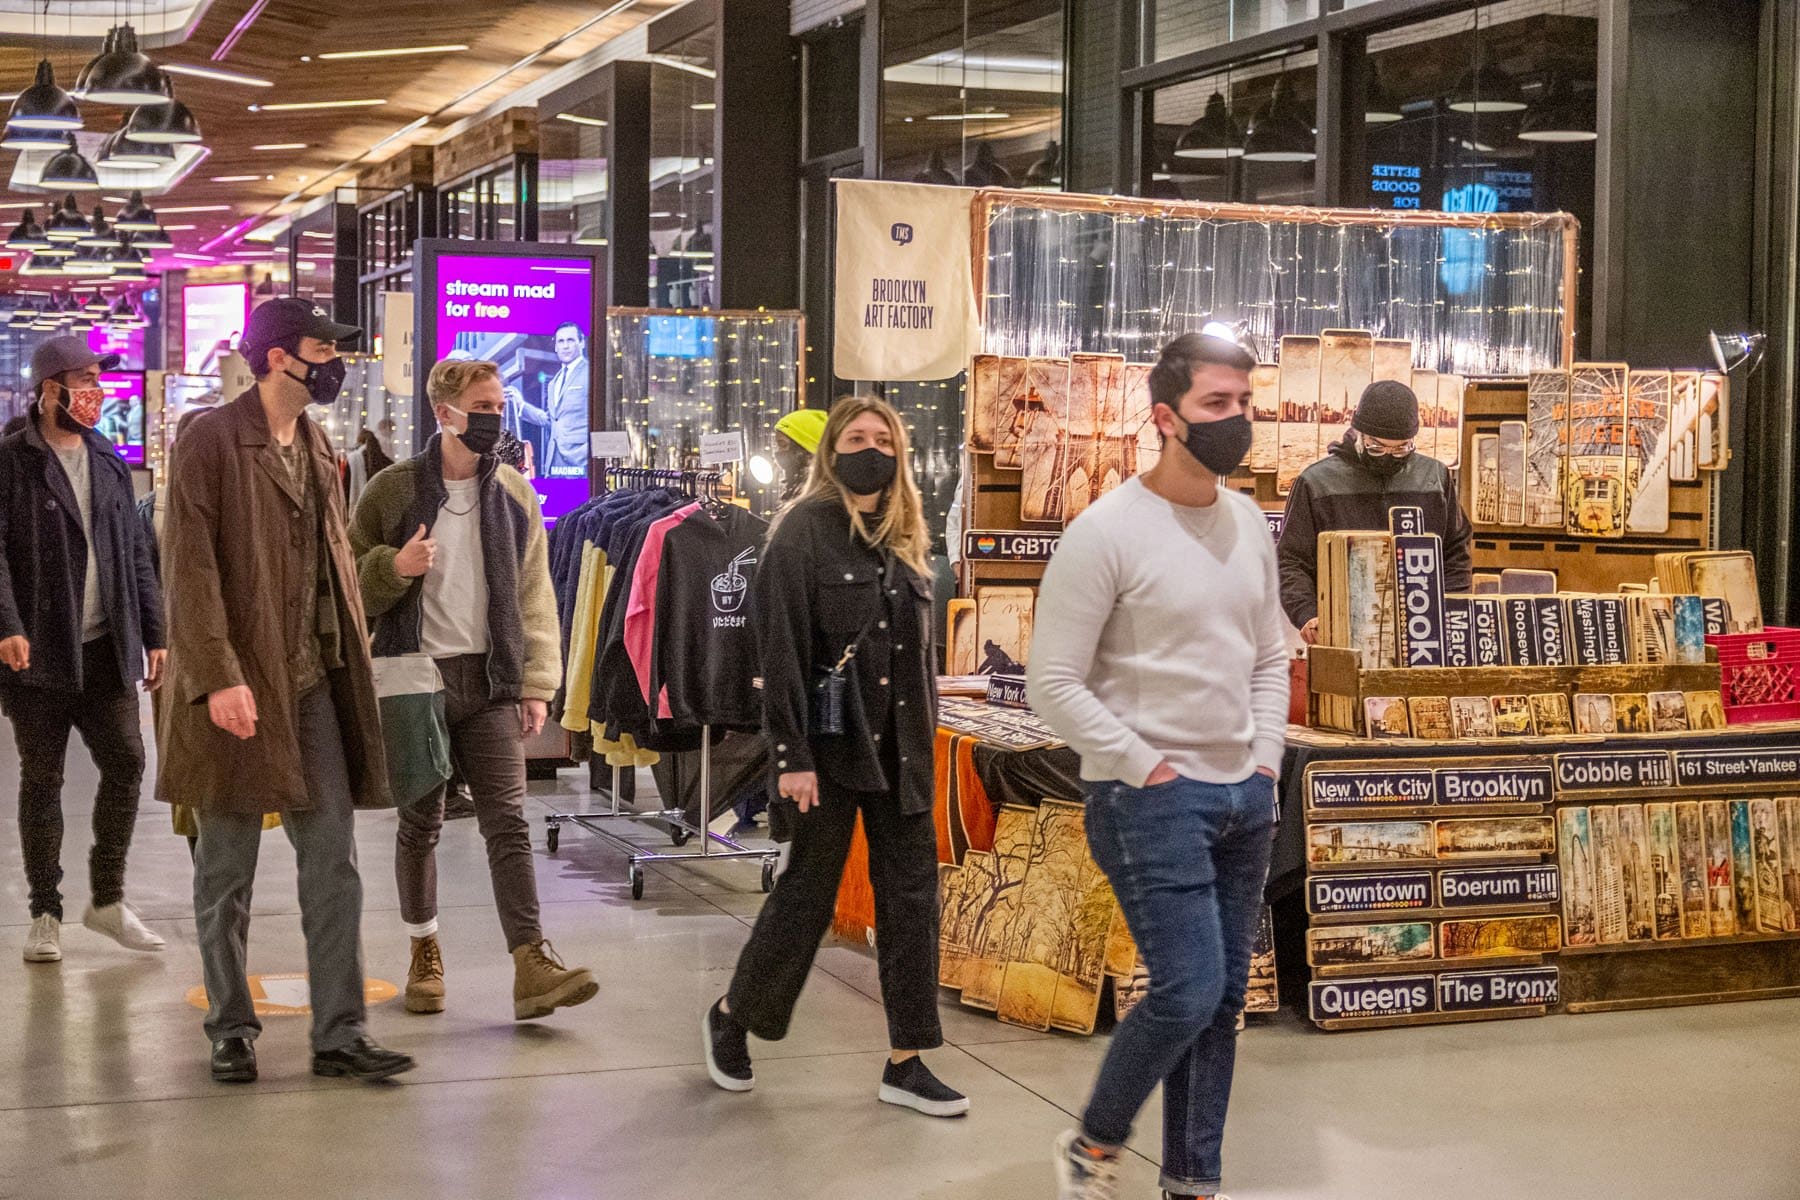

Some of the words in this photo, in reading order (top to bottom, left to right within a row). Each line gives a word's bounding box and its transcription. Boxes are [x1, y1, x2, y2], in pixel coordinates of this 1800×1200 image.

[446, 280, 509, 297] stream
[513, 282, 556, 299] mad
[872, 278, 926, 304] BROOKLYN
[445, 300, 470, 317] for
[474, 301, 510, 318] free
[864, 304, 885, 328] ART
[888, 304, 934, 329] FACTORY
[1557, 423, 1642, 447] WHEEL
[1513, 600, 1530, 666] Rooseve
[1603, 600, 1622, 665] Financial
[987, 682, 1002, 701] New
[1003, 684, 1019, 702] York
[1559, 760, 1633, 784] Cobble
[1638, 759, 1671, 781] Hill
[1679, 761, 1702, 776] 161
[1705, 758, 1797, 775] Street-Yankee
[1313, 780, 1351, 797] New
[1355, 779, 1395, 797] York
[1398, 778, 1432, 800] City
[1444, 774, 1545, 802] Brooklyn
[1315, 882, 1427, 905] Downtown
[1442, 877, 1520, 898] Boerum
[1526, 872, 1557, 893] Hill
[1320, 985, 1428, 1013] Queens
[1440, 979, 1484, 1003] The
[1490, 977, 1558, 1001] Bronx
